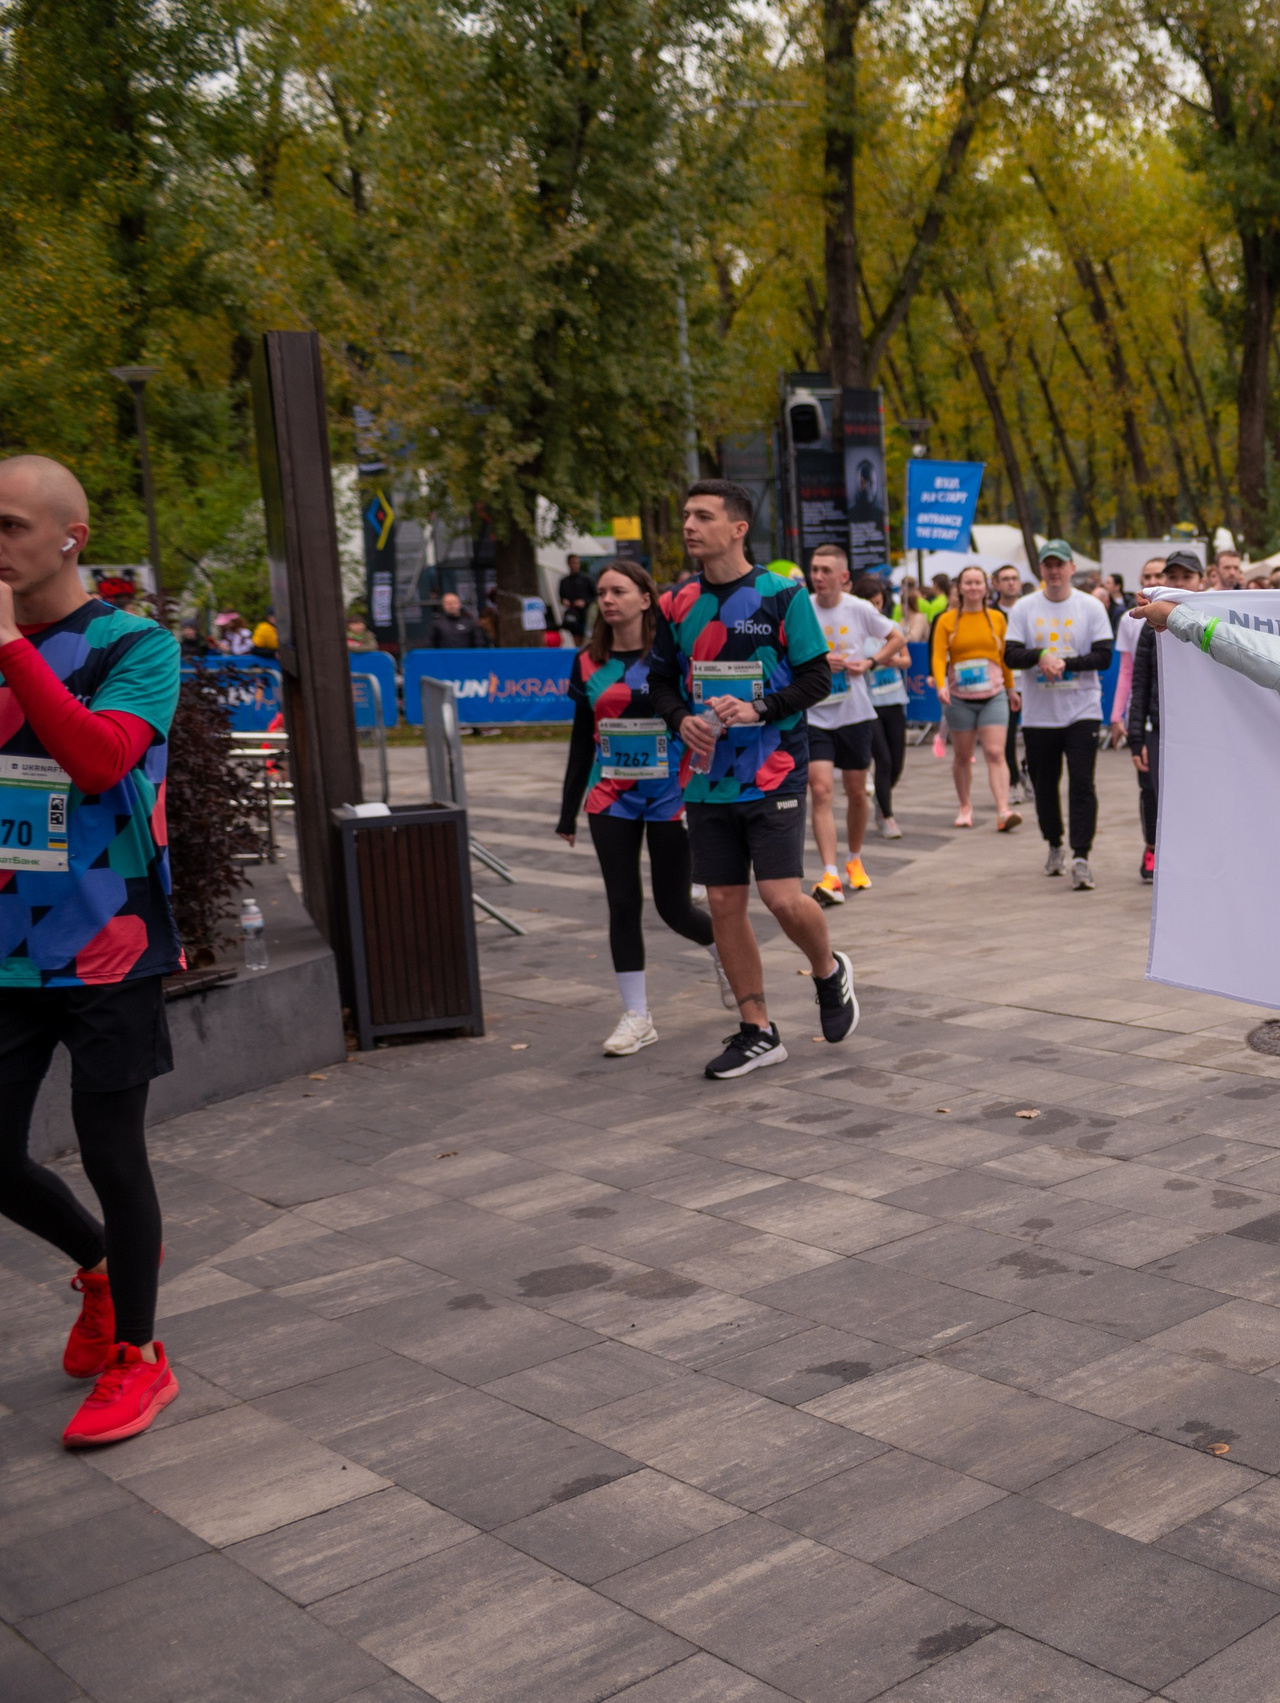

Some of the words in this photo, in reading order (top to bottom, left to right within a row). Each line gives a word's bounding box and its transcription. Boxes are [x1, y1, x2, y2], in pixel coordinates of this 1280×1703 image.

[917, 513, 963, 528] ENTRANCE
[932, 528, 960, 541] START
[735, 619, 772, 635] Ябко
[451, 678, 489, 698] UN
[614, 751, 651, 767] 7262
[22, 763, 67, 774] UKRNAFT
[776, 798, 799, 810] PUMA
[1, 818, 33, 847] 70
